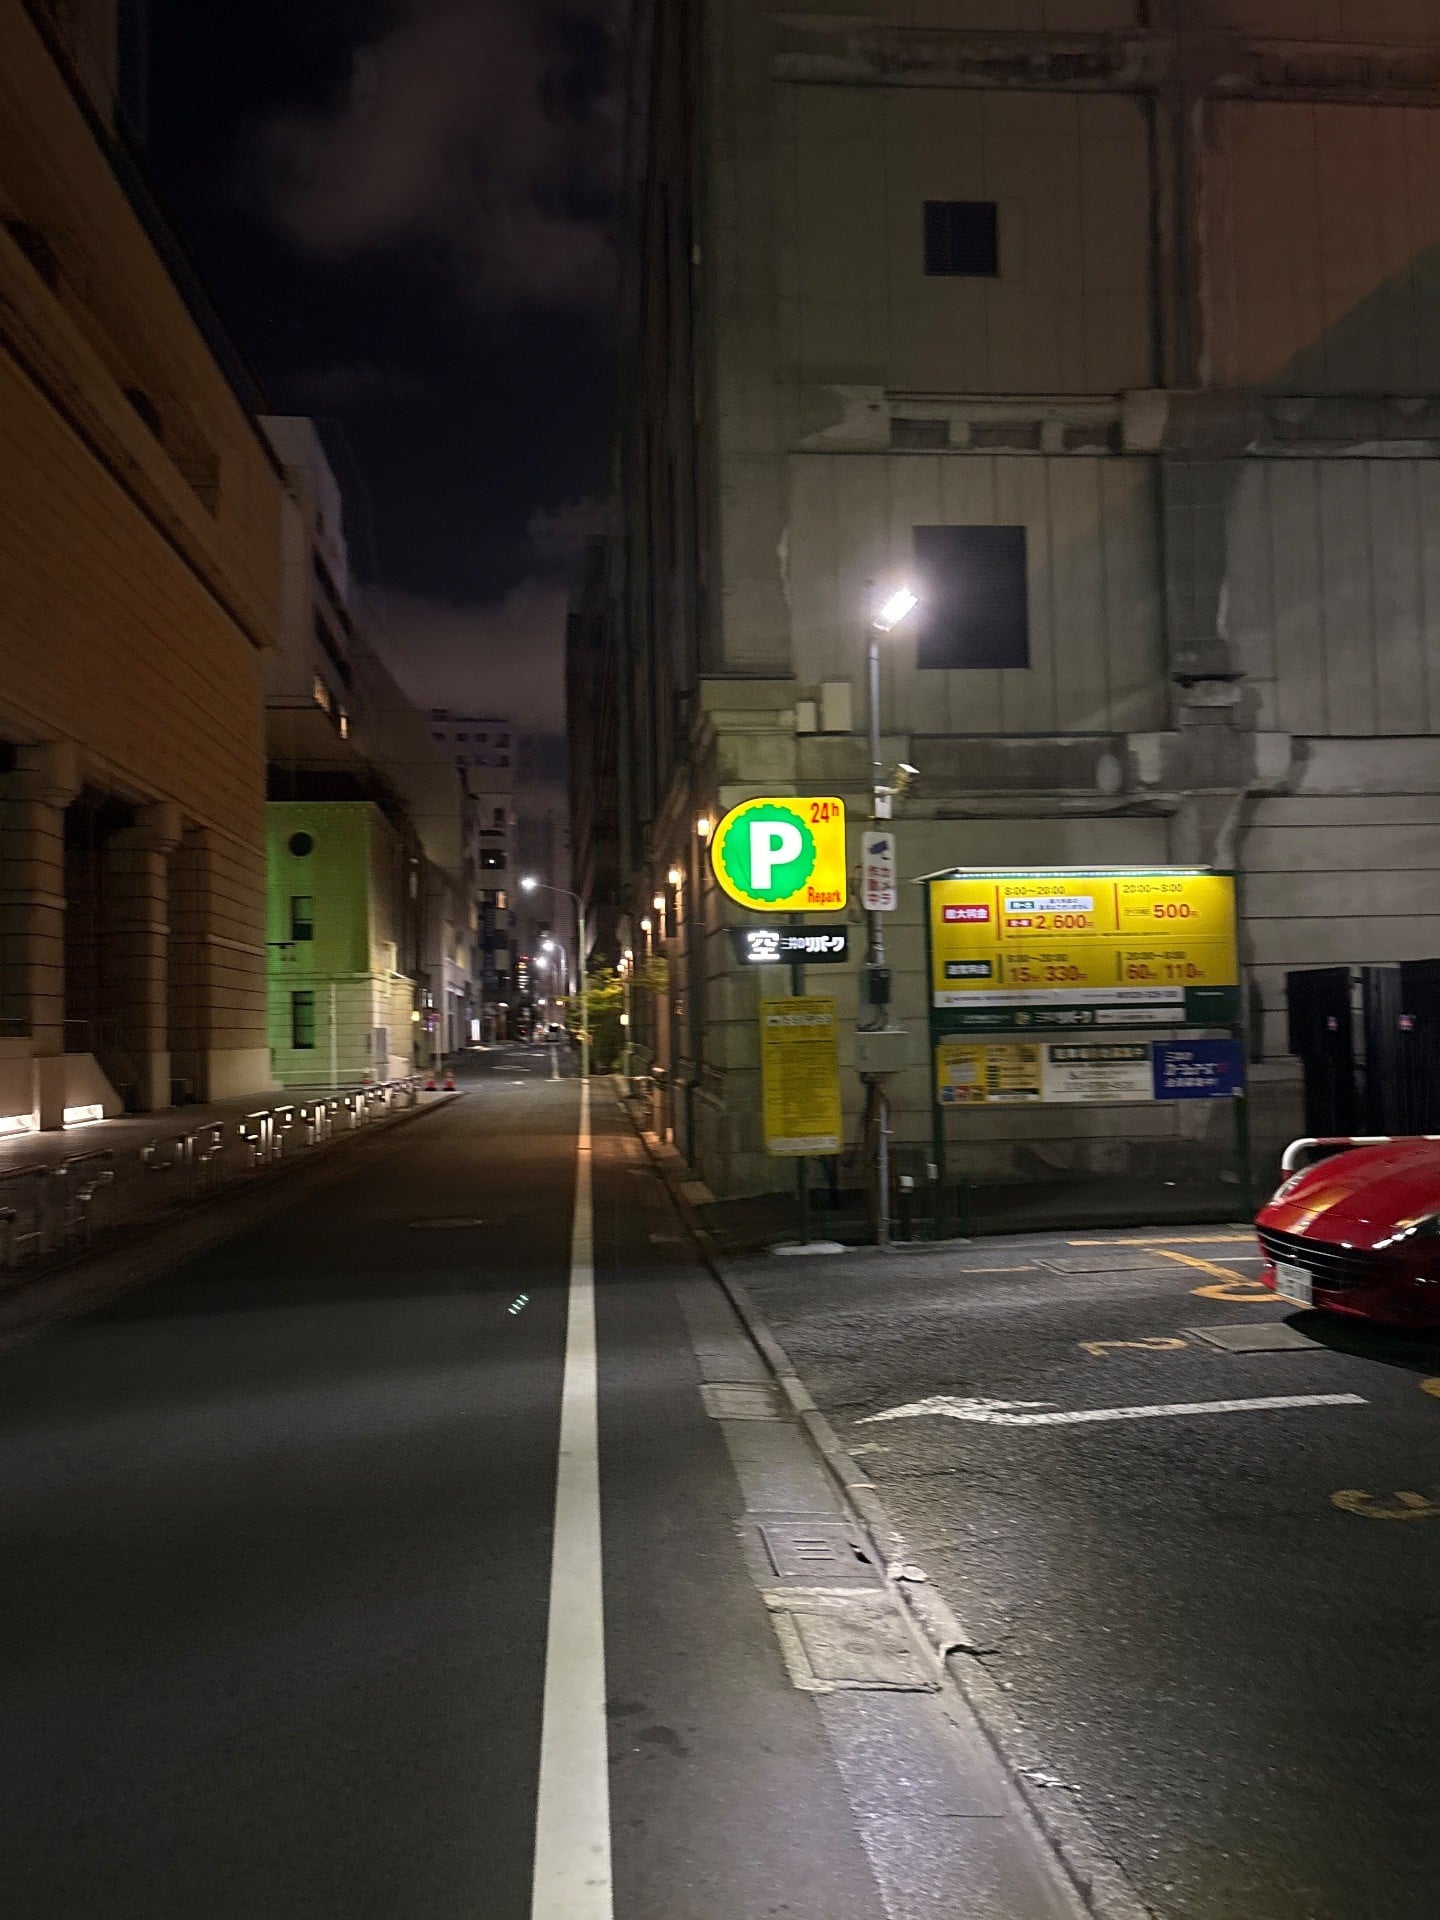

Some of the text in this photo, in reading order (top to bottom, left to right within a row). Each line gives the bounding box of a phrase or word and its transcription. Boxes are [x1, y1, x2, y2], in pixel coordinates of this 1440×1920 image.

[810, 802, 840, 823] 24h
[749, 820, 803, 890] P
[808, 886, 842, 904] Repark
[1153, 903, 1199, 918] 500
[1035, 914, 1095, 929] 2,600
[747, 930, 781, 961] 空
